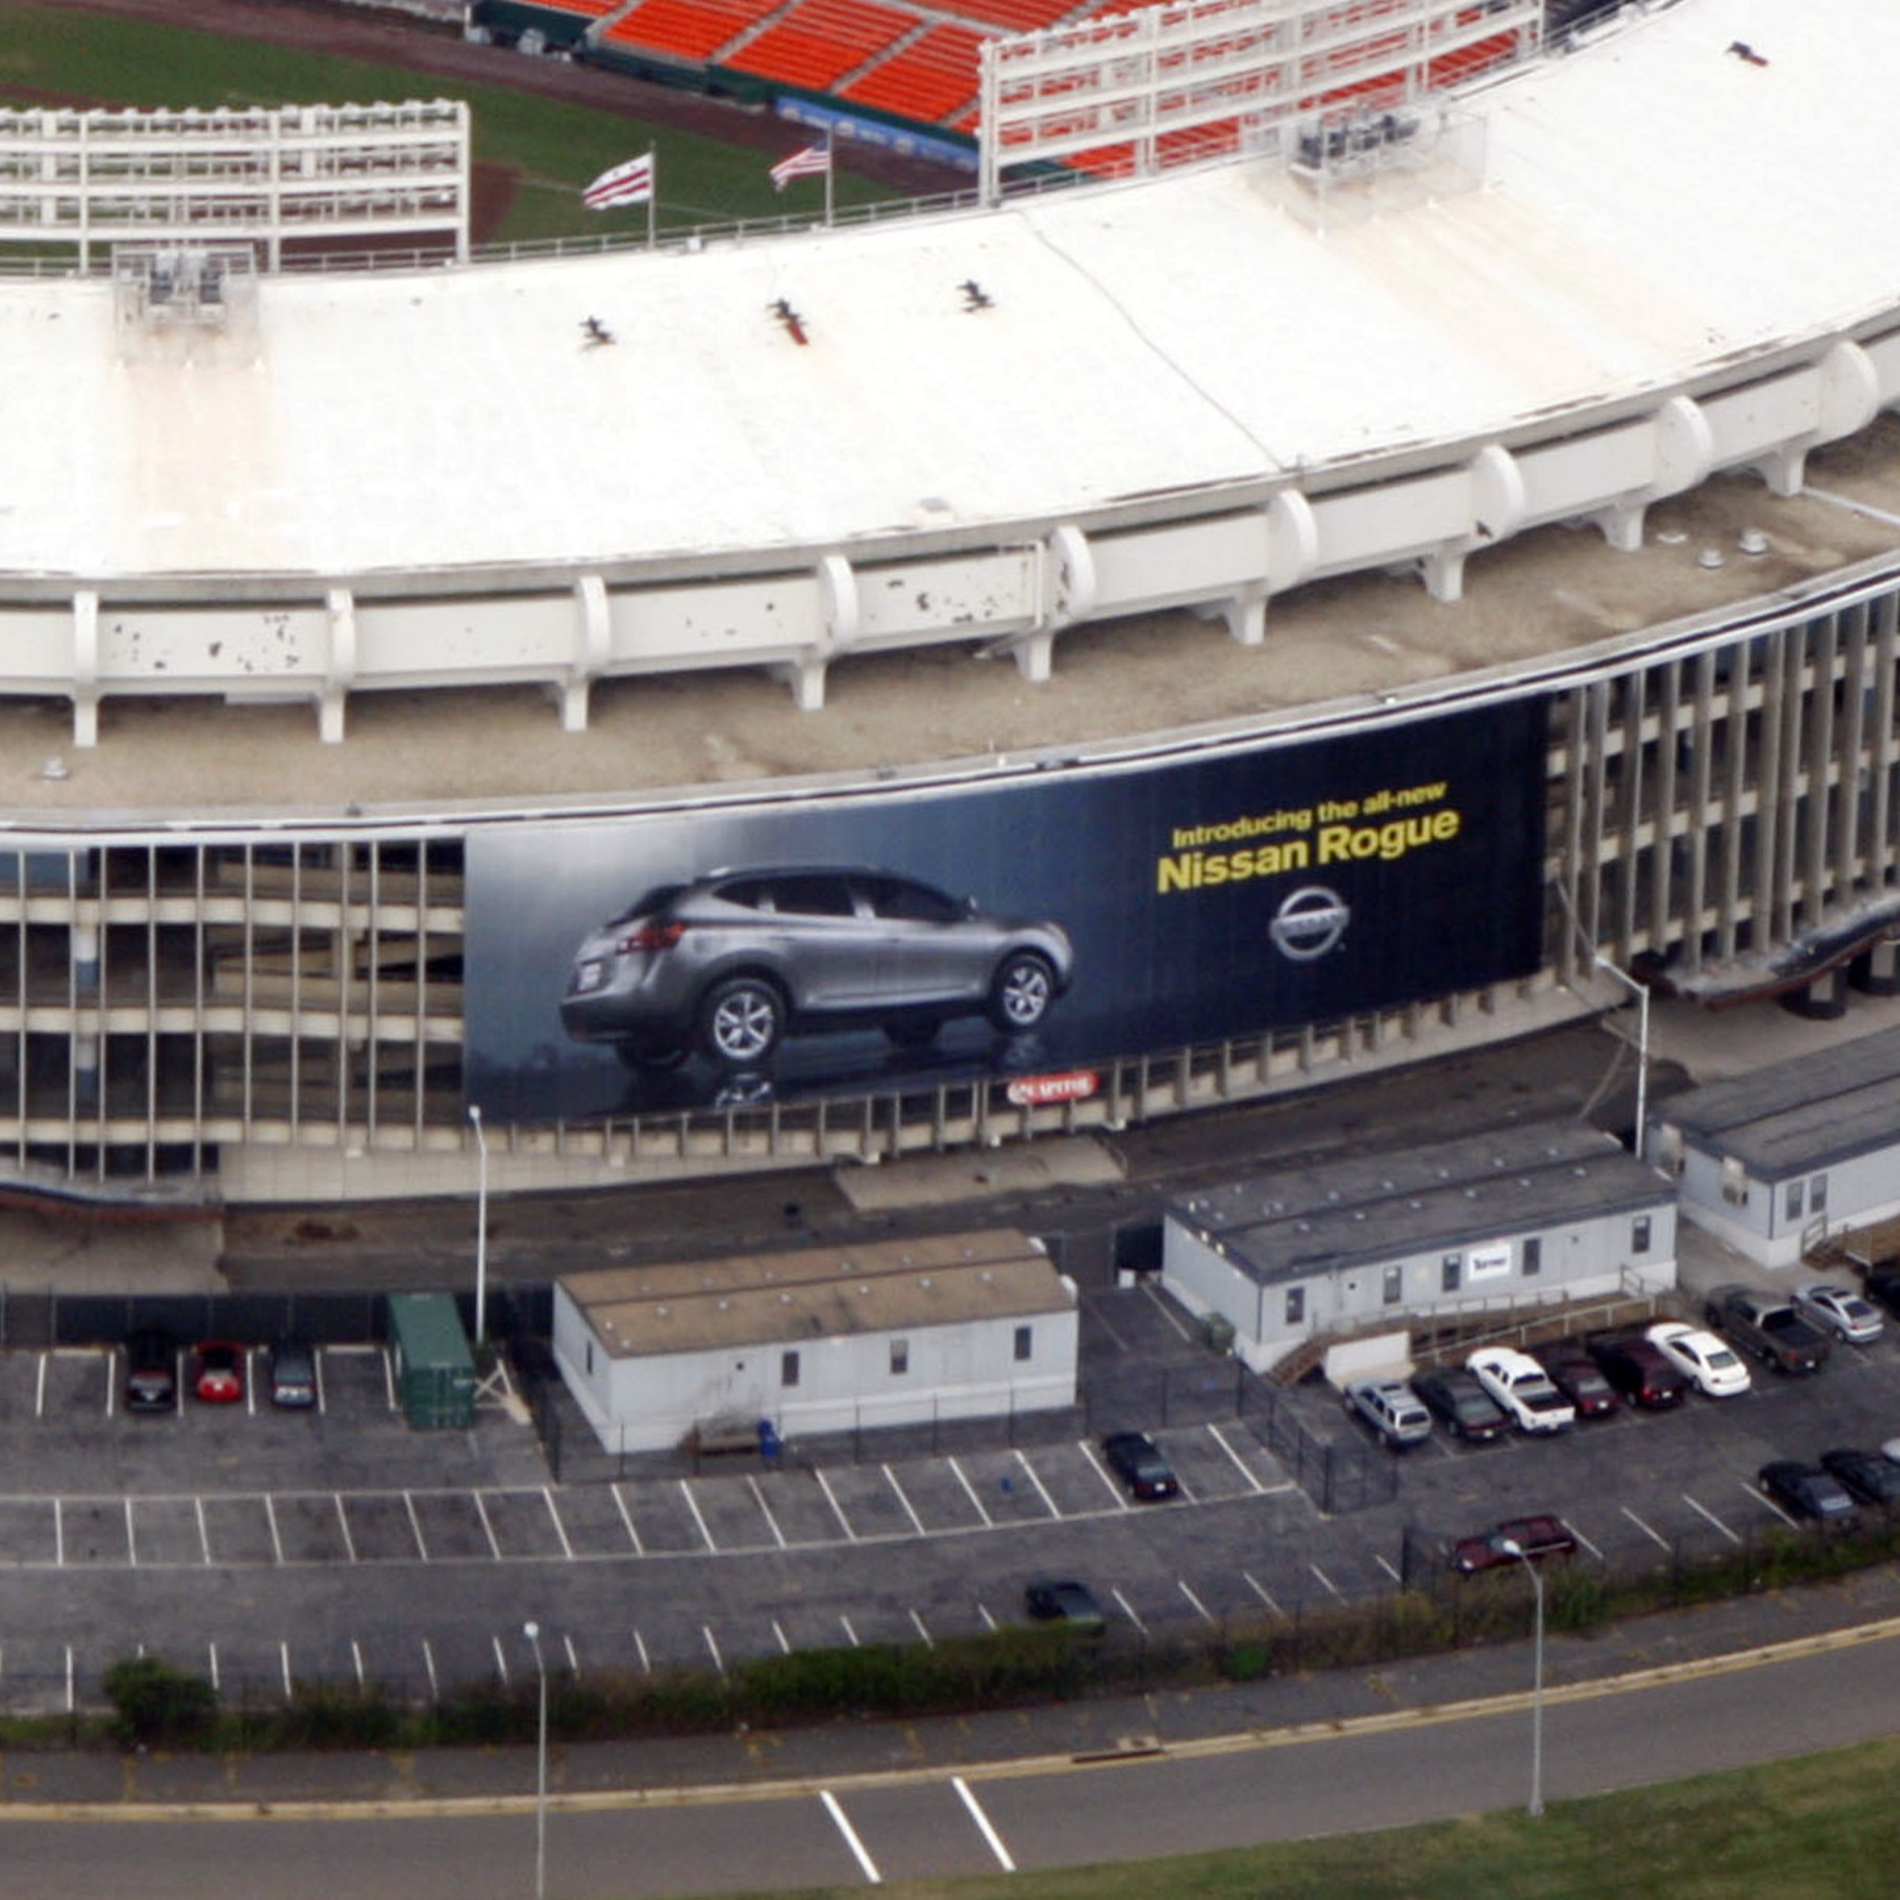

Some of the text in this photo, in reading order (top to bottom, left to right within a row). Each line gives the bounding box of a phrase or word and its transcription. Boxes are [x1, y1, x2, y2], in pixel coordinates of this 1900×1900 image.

[1157, 810, 1460, 893] Nissan Rogue
[1173, 781, 1448, 849] Introducing the all-new
